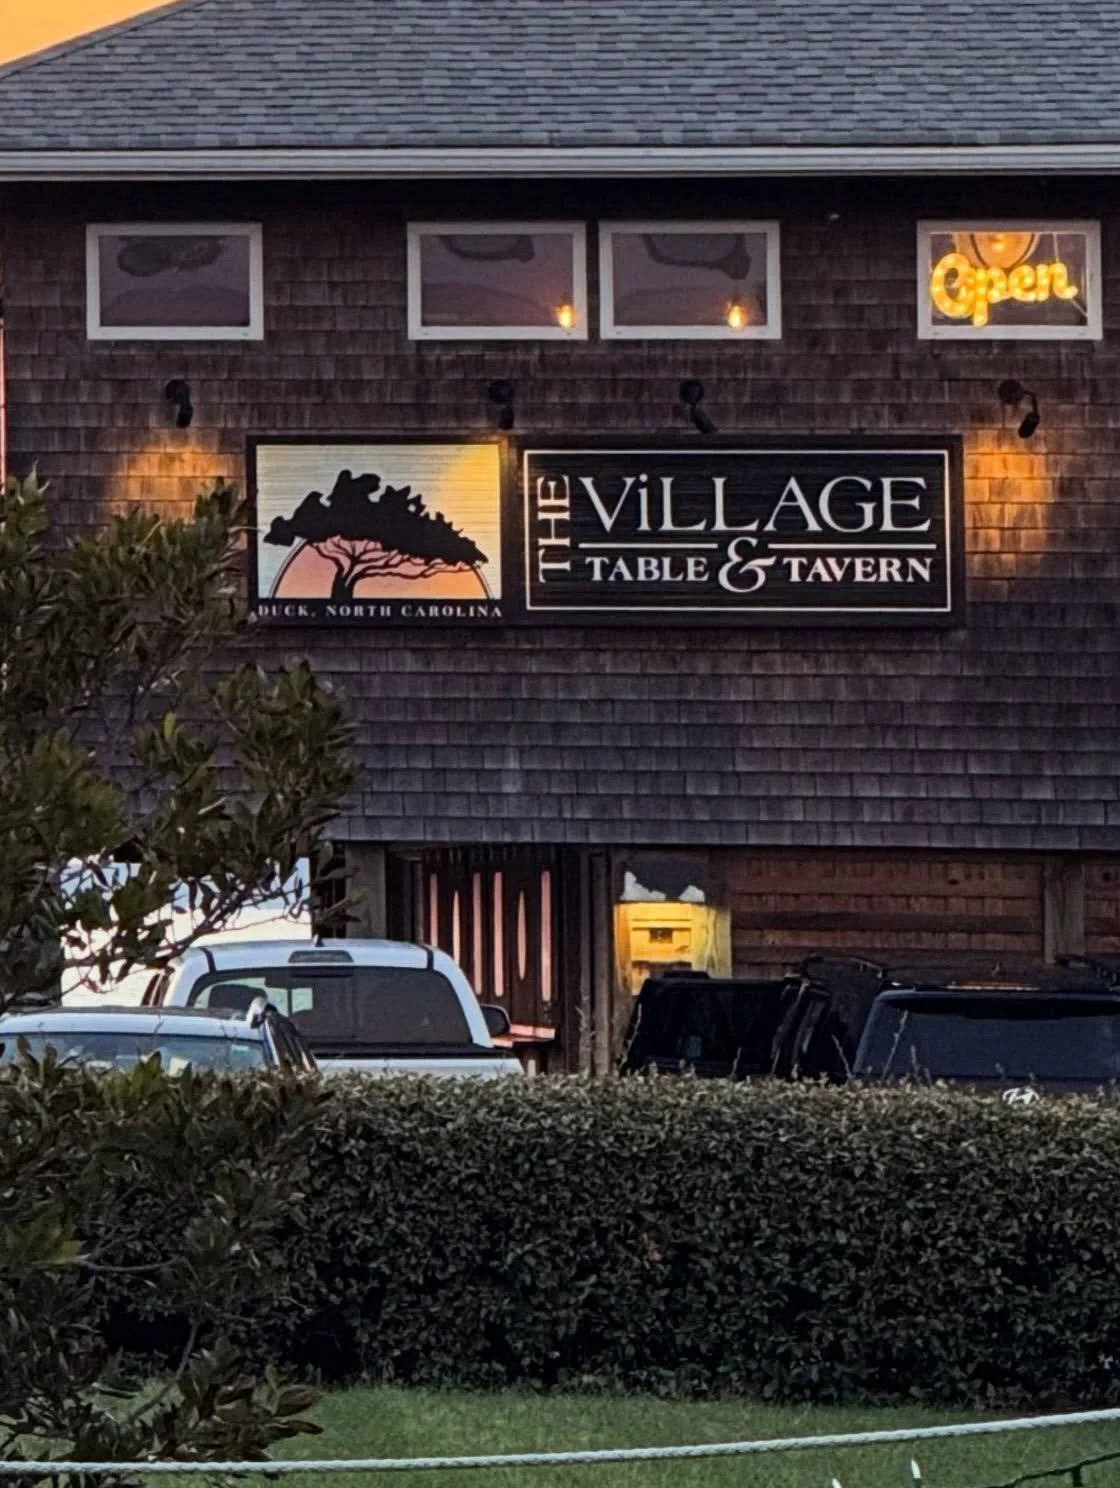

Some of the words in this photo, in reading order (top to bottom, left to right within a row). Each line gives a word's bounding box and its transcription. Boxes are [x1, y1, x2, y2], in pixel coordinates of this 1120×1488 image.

[932, 252, 1078, 327] Open
[537, 475, 571, 583] THE
[585, 556, 709, 582] TABLE
[717, 536, 777, 593] &
[782, 556, 933, 583] TAVERN
[258, 604, 318, 617] DUCK,
[326, 604, 392, 617] NORTH
[401, 604, 503, 618] CAROLINA
